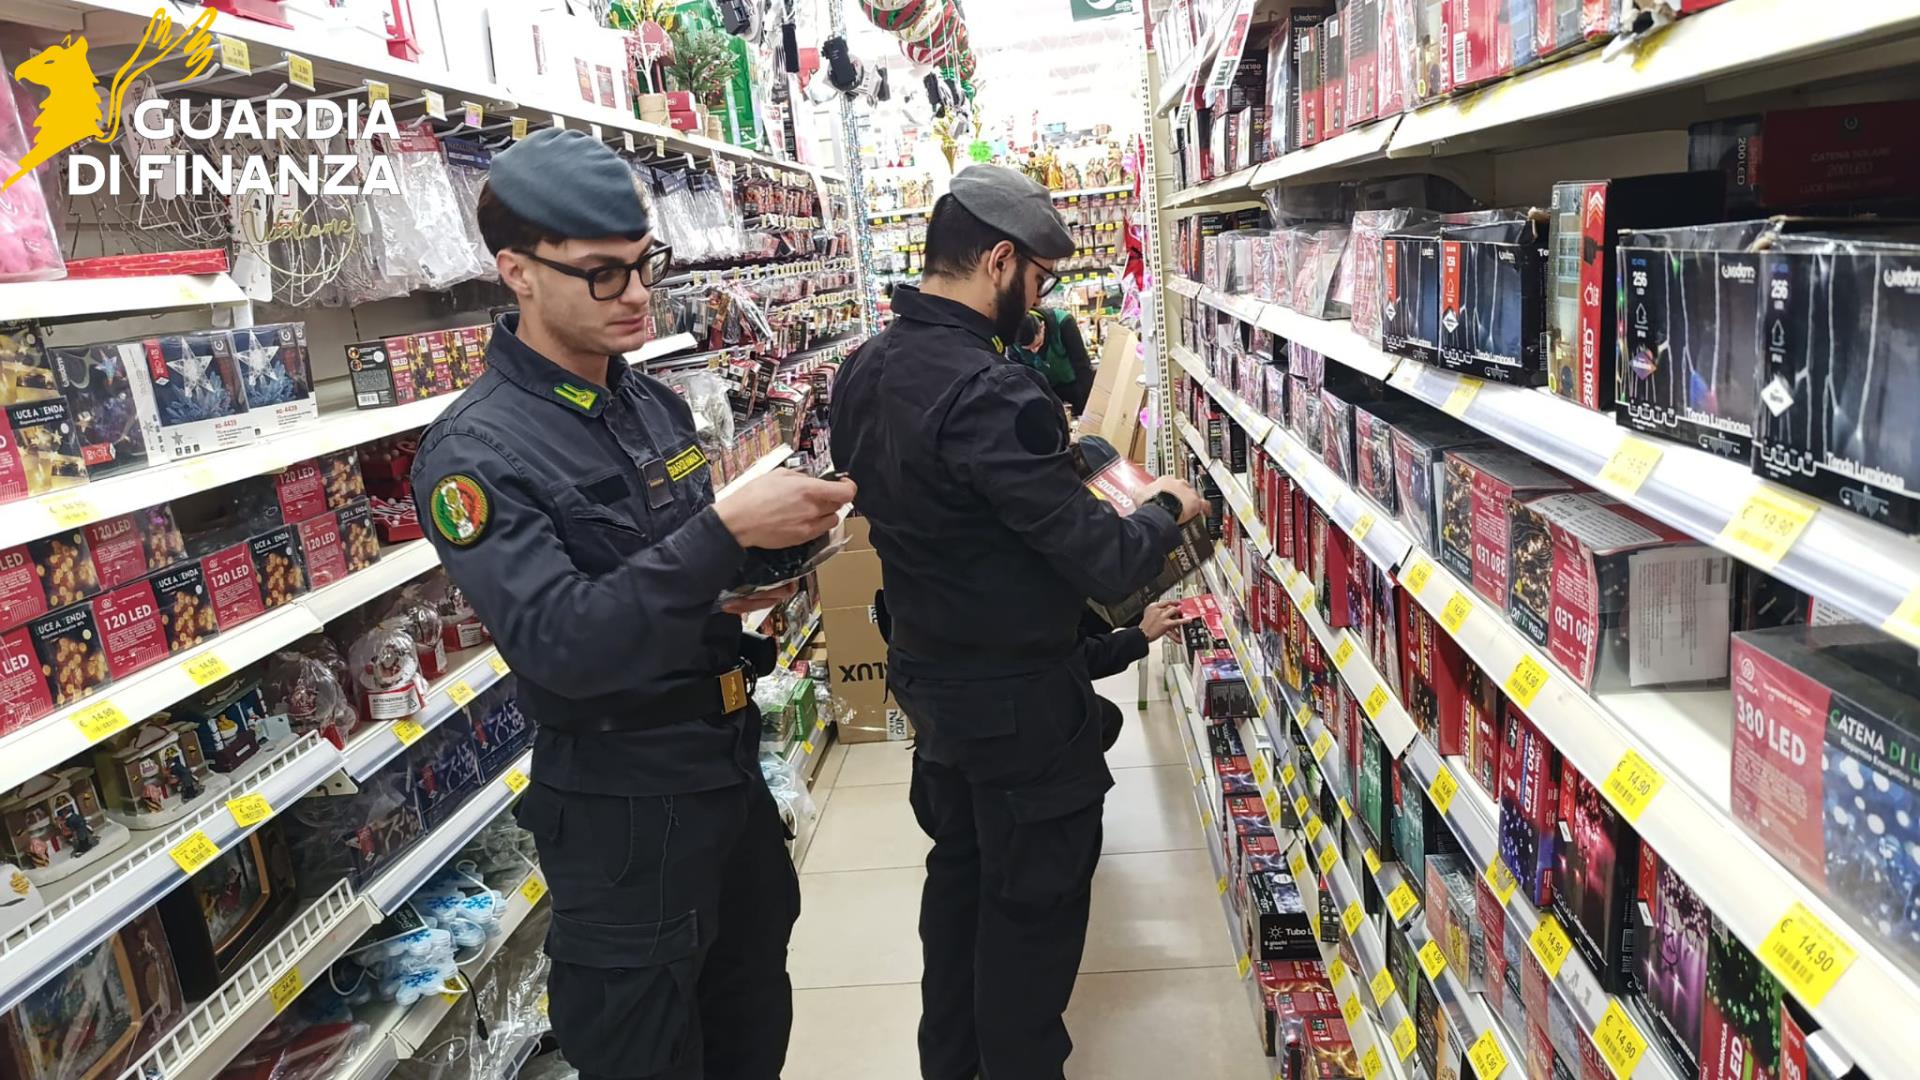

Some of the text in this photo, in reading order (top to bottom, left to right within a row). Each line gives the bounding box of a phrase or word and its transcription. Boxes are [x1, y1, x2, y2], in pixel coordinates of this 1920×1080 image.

[241, 209, 355, 245] Welcome
[1633, 271, 1648, 287] 256
[1771, 279, 1788, 299] 256
[1686, 407, 1751, 433] Tenda Luminosa
[280, 466, 315, 484] 120 LED
[1826, 452, 1905, 489] Tenda Luminosa
[92, 519, 132, 541] 120 LED
[306, 531, 336, 551] 120 LED
[0, 552, 24, 572] LED
[1476, 543, 1506, 578] LED 380
[211, 564, 249, 589] 120 LED
[104, 604, 152, 631] 120 LED
[1554, 605, 1573, 635] LED
[2, 653, 30, 675] LED
[838, 661, 888, 684] LUX
[1737, 694, 1764, 740] 380
[1768, 718, 1807, 766] LED
[1829, 708, 1886, 755] CATENA
[1889, 740, 1907, 767] DI
[1524, 733, 1536, 813] 400 LED
[1616, 760, 1652, 797] € 14,90
[1285, 928, 1307, 936] Tubo
[1540, 920, 1563, 956] € 14,90
[1779, 917, 1834, 972] € 14,90
[1605, 1014, 1637, 1059] € 14,90
[1594, 1049, 1611, 1080] LED
